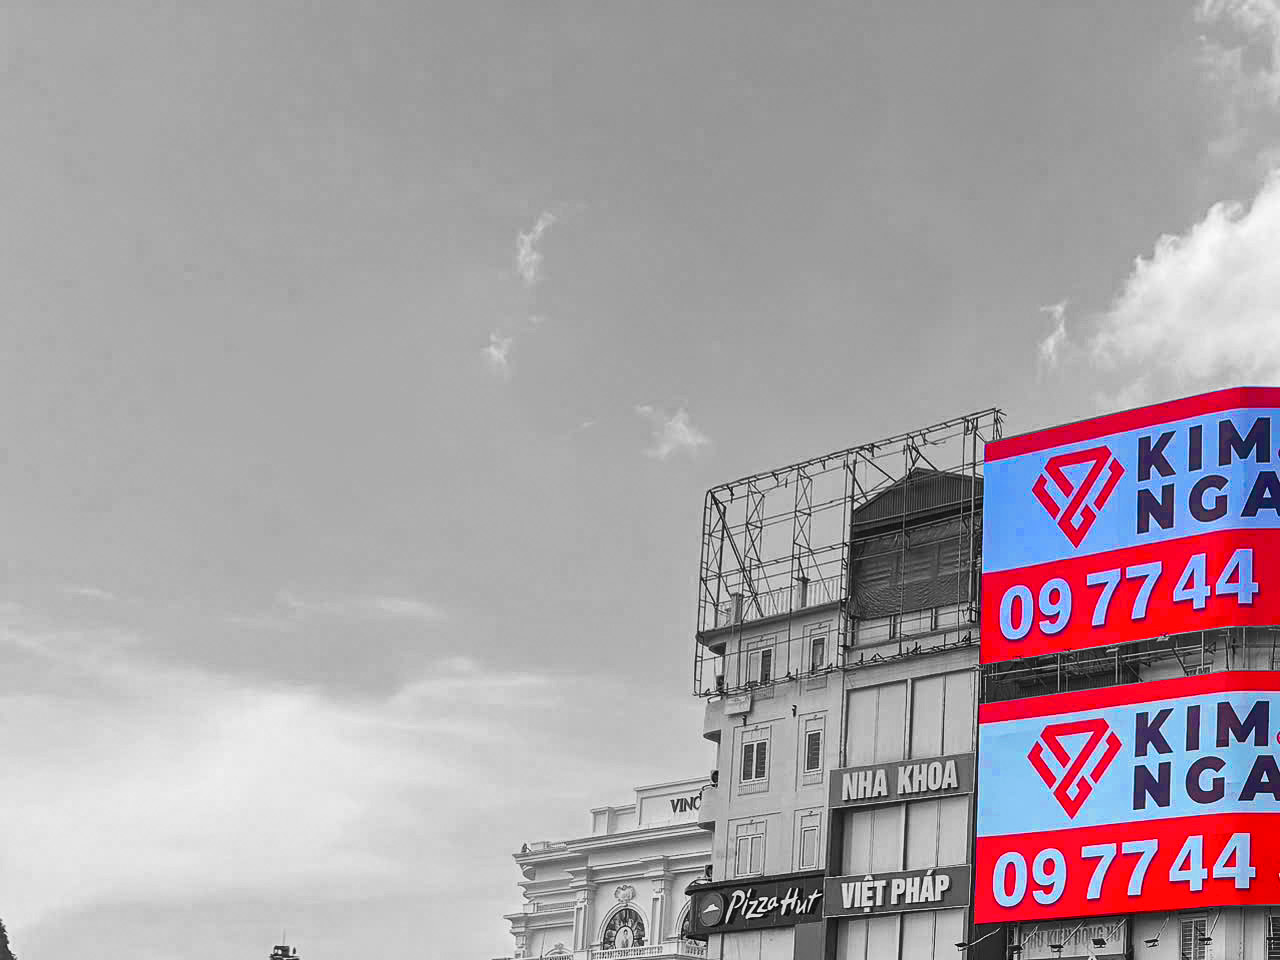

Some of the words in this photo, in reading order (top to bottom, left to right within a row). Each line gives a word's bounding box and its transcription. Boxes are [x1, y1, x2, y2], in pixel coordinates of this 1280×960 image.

[1137, 417, 1271, 482] KIM
[999, 577, 1072, 640] 09
[1086, 560, 1163, 626] 77
[1172, 548, 1259, 610] 44
[1134, 700, 1270, 758] KIM
[841, 768, 888, 801] NHA
[897, 759, 958, 794] KHOA
[841, 874, 888, 912] VIỆT
[890, 870, 950, 905] PHÁP
[992, 847, 1067, 908] 09
[1081, 838, 1159, 900] 77
[1168, 832, 1256, 892] 44
[725, 888, 779, 923] Pizza
[780, 887, 823, 917] Hut
